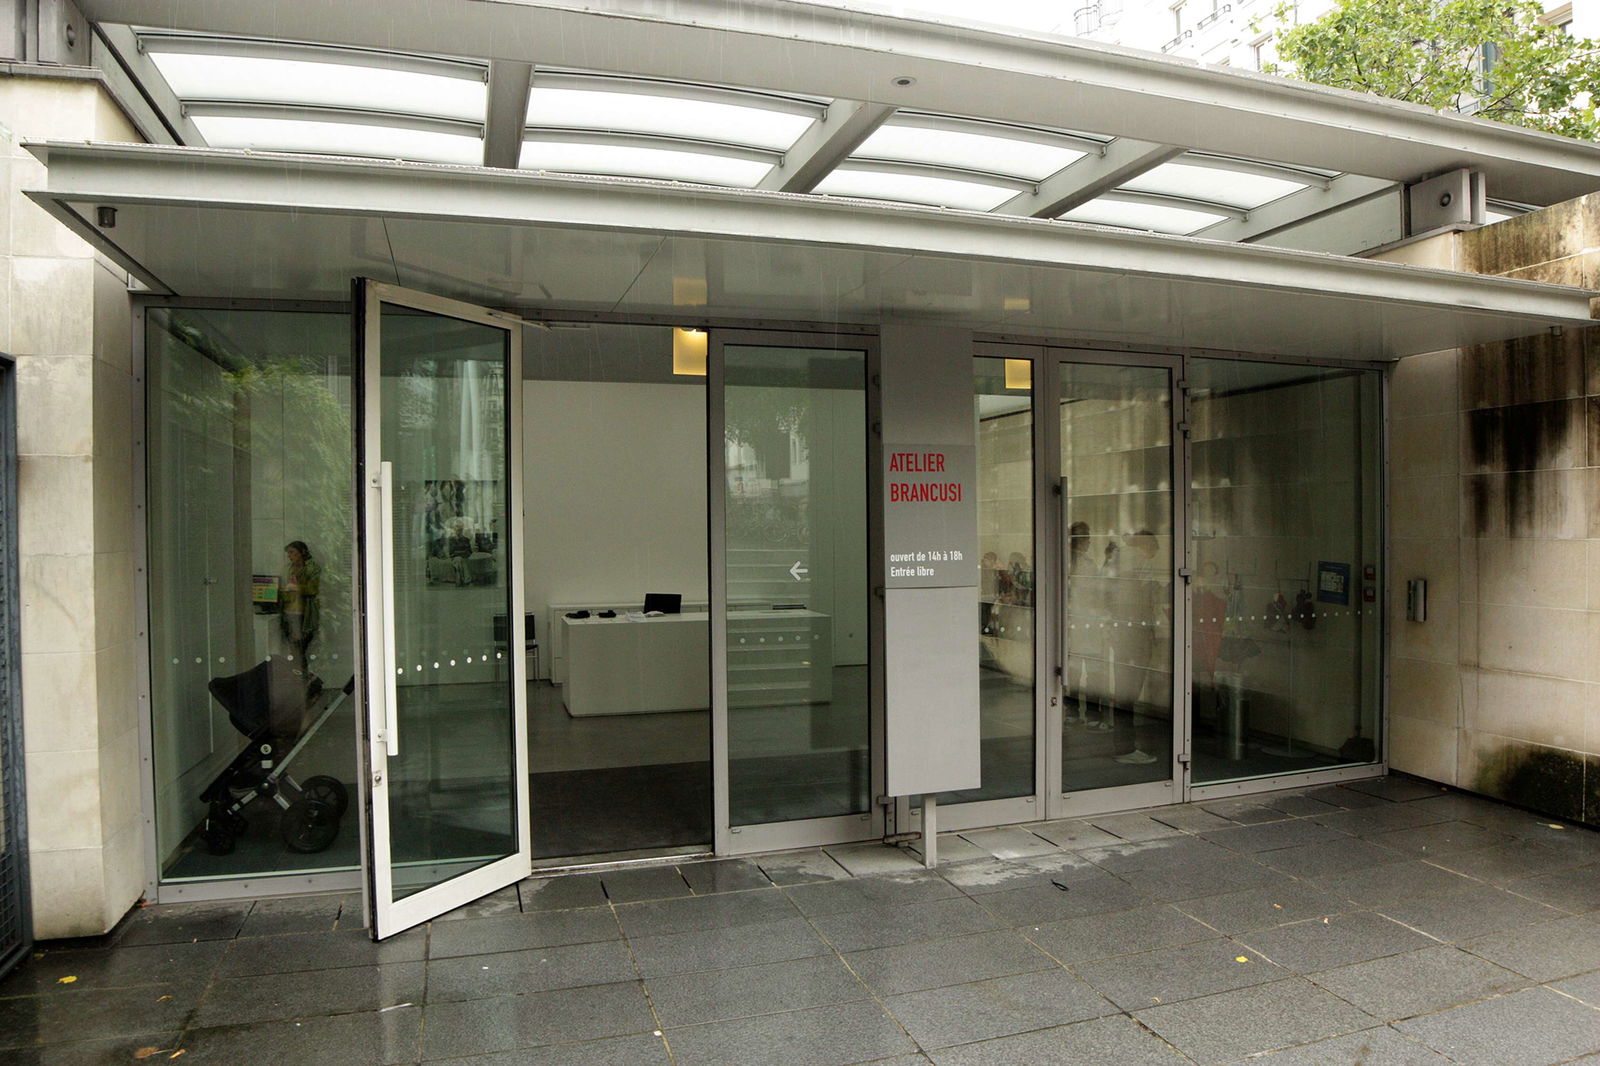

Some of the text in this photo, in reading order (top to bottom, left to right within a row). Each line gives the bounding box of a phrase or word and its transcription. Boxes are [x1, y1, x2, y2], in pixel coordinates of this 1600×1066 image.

[889, 453, 944, 472] ATELIER
[890, 483, 962, 502] BRANCUSI
[890, 551, 963, 562] ouvert de 14h à 18h
[890, 565, 934, 577] Entrée libre
